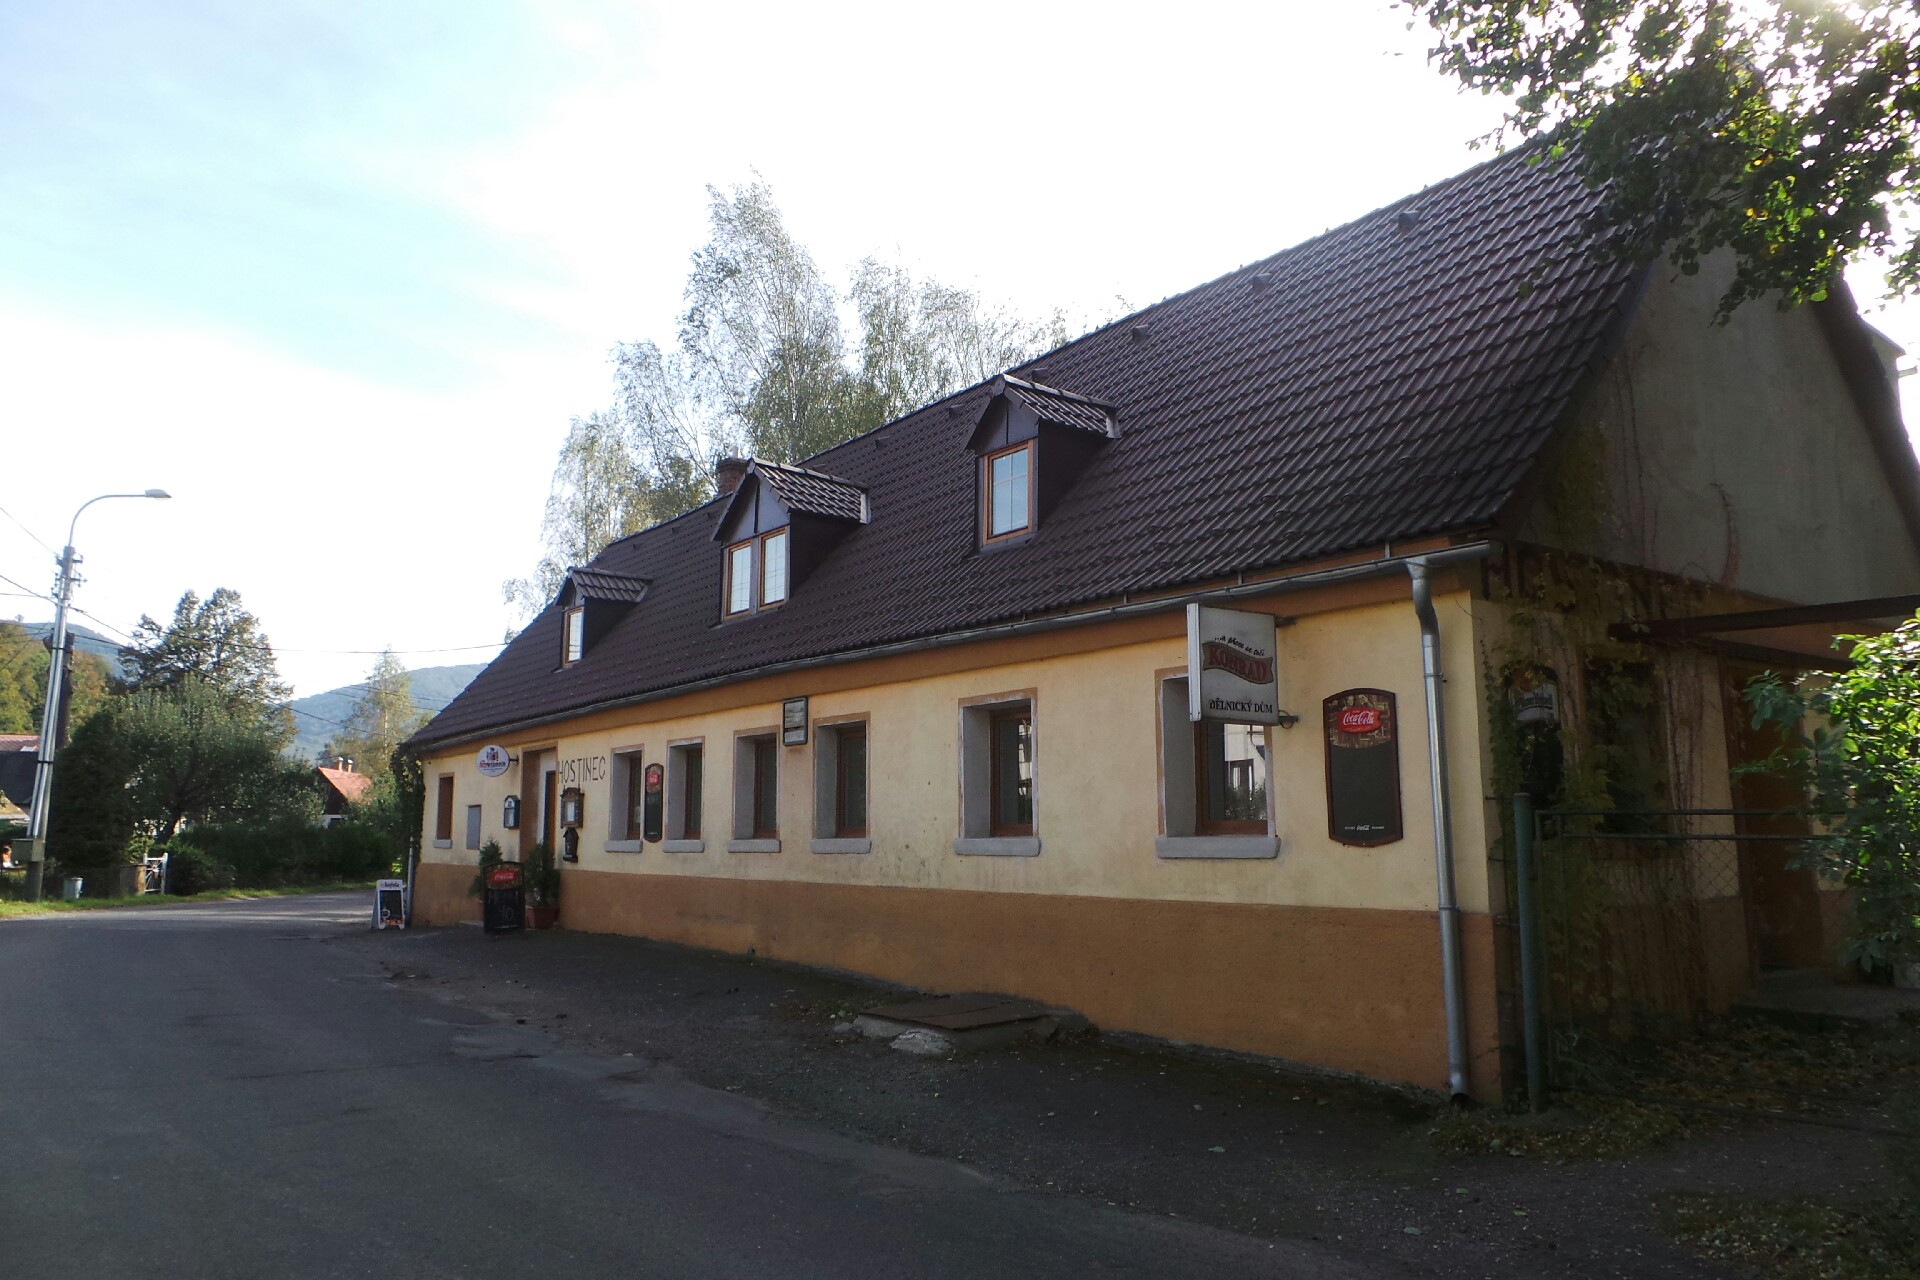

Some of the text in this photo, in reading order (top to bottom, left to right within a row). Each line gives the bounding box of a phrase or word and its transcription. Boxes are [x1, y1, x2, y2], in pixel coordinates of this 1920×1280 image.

[1208, 645, 1269, 681] KONRAD
[1209, 698, 1273, 713] DĚLNICKÝ DŮM
[558, 755, 606, 784] HOSTINEC
